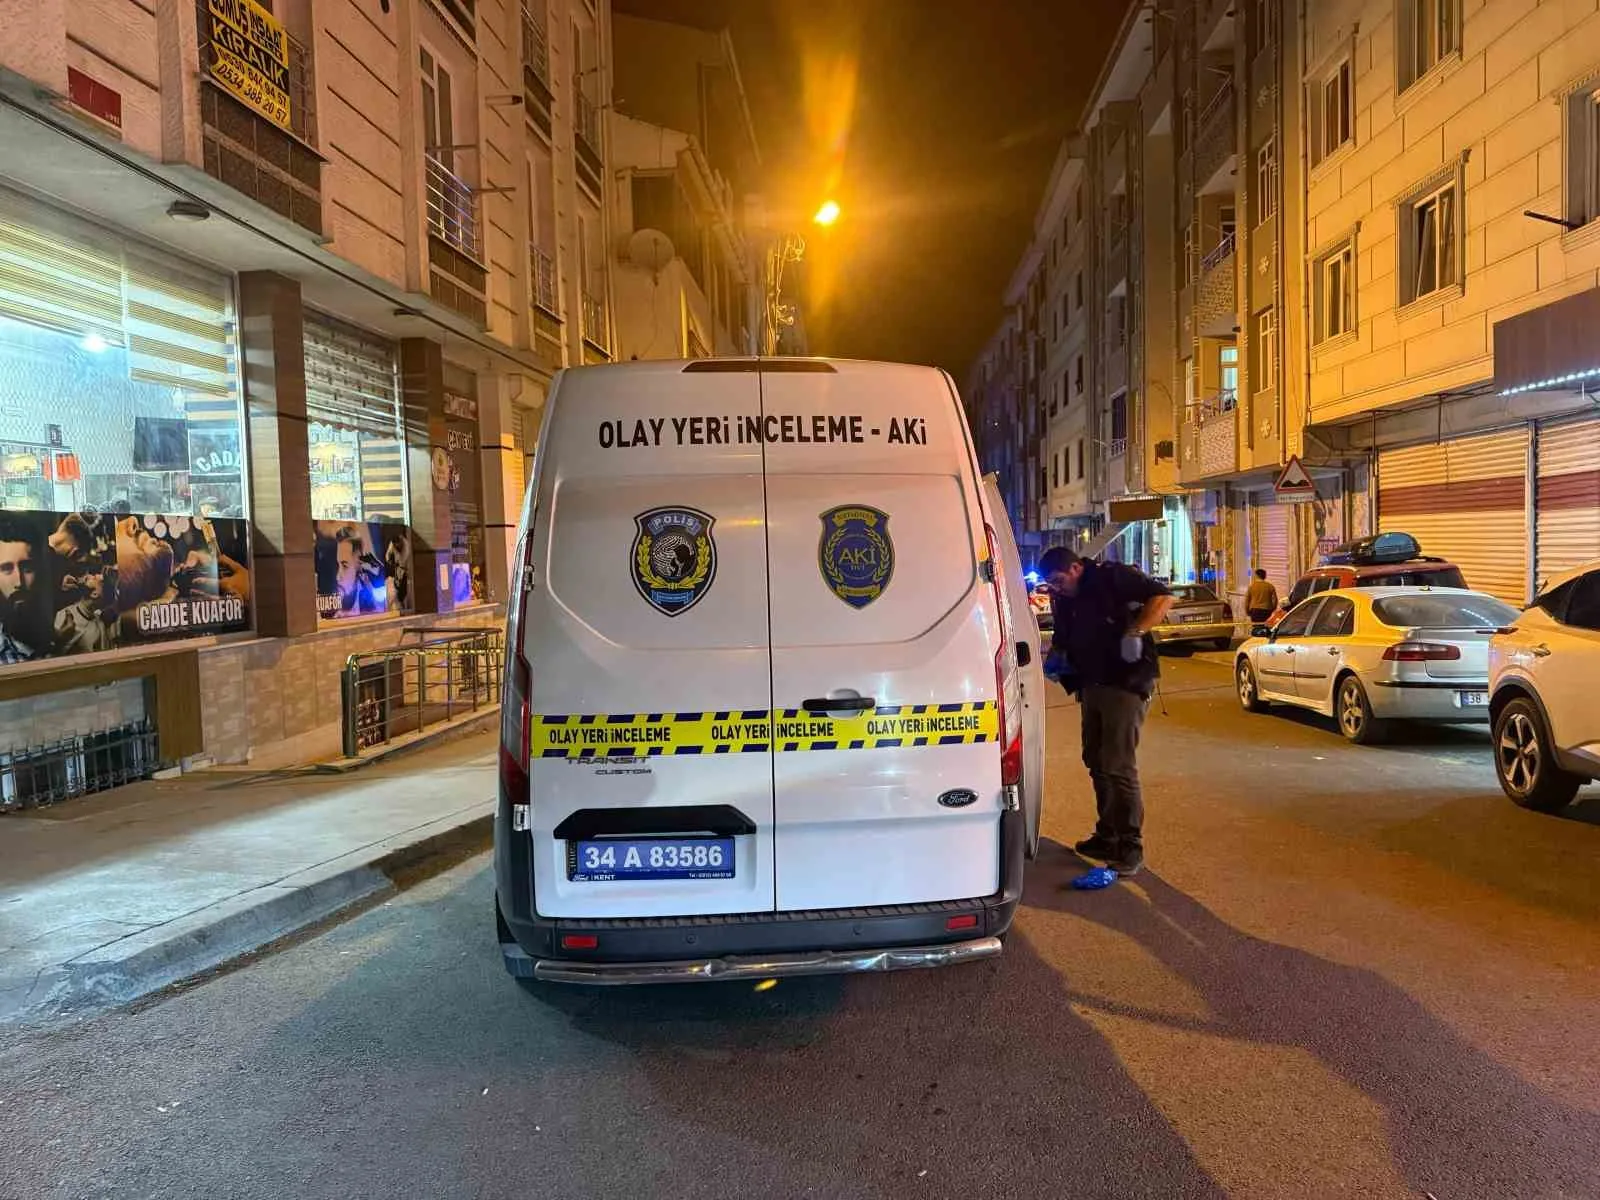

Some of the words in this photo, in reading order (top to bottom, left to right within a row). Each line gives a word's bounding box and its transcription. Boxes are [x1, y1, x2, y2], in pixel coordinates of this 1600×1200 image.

[599, 418, 665, 449] OLAY
[139, 602, 189, 631] CADDE
[191, 593, 243, 625] KUAFÖR
[549, 728, 579, 744] OLAY
[711, 725, 741, 740] OLAY
[867, 719, 896, 735] OLAY
[585, 846, 617, 869] 34
[623, 846, 643, 868] A
[649, 845, 723, 867] 83586
